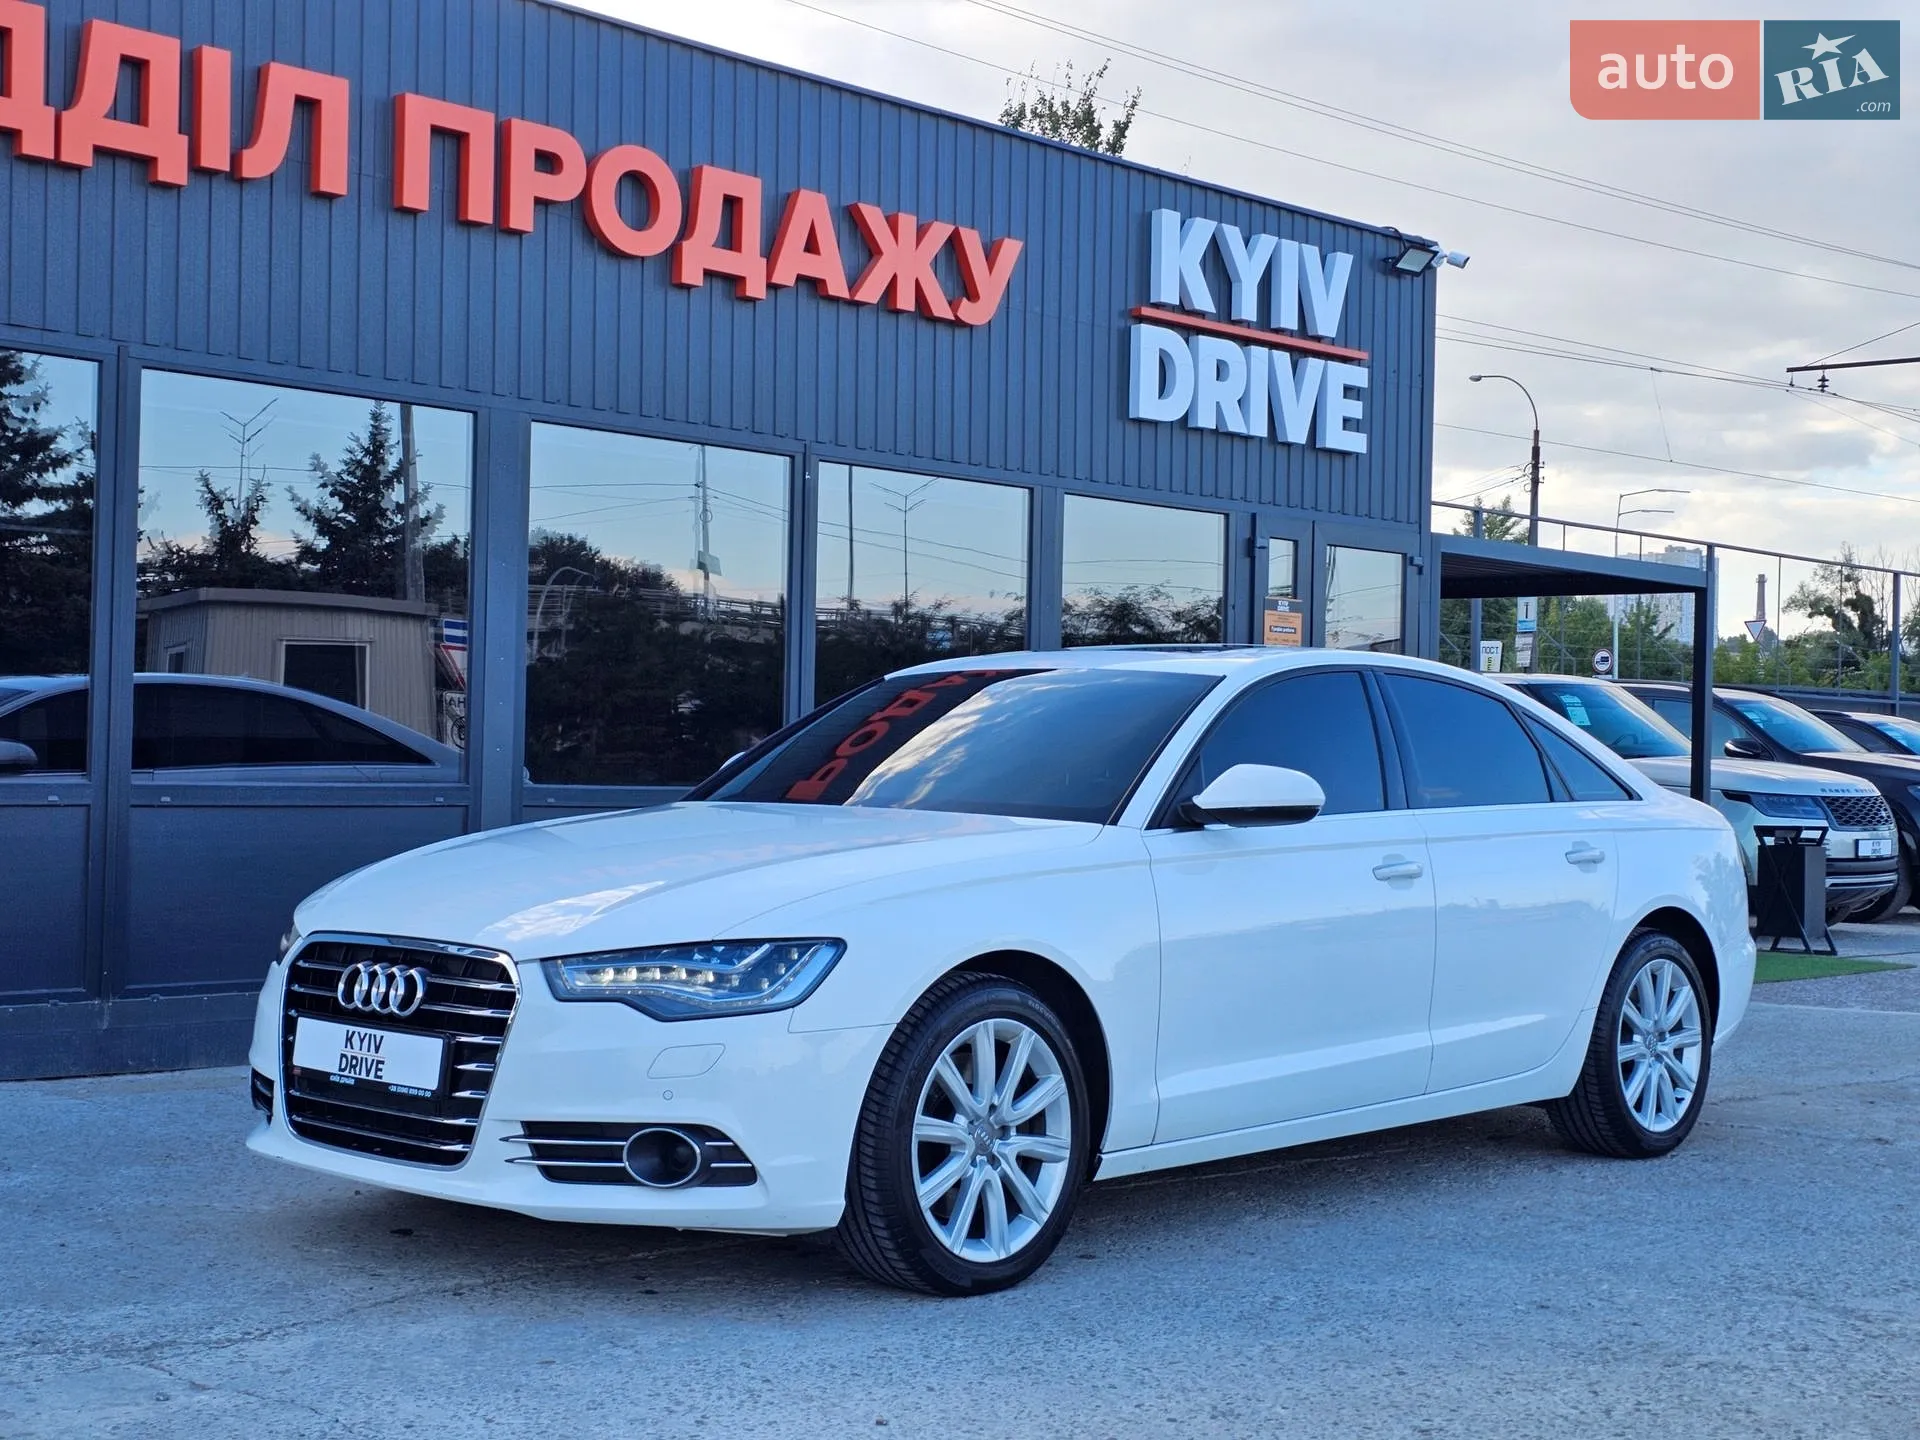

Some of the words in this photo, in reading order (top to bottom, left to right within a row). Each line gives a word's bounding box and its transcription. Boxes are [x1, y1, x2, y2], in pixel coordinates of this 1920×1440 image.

[394, 92, 1023, 326] ПРОДАЖУ
[1150, 207, 1354, 338] KYIV
[1129, 323, 1369, 454] DRIVE
[338, 1053, 385, 1080] DRIVE
[345, 1029, 384, 1055] KYIV
